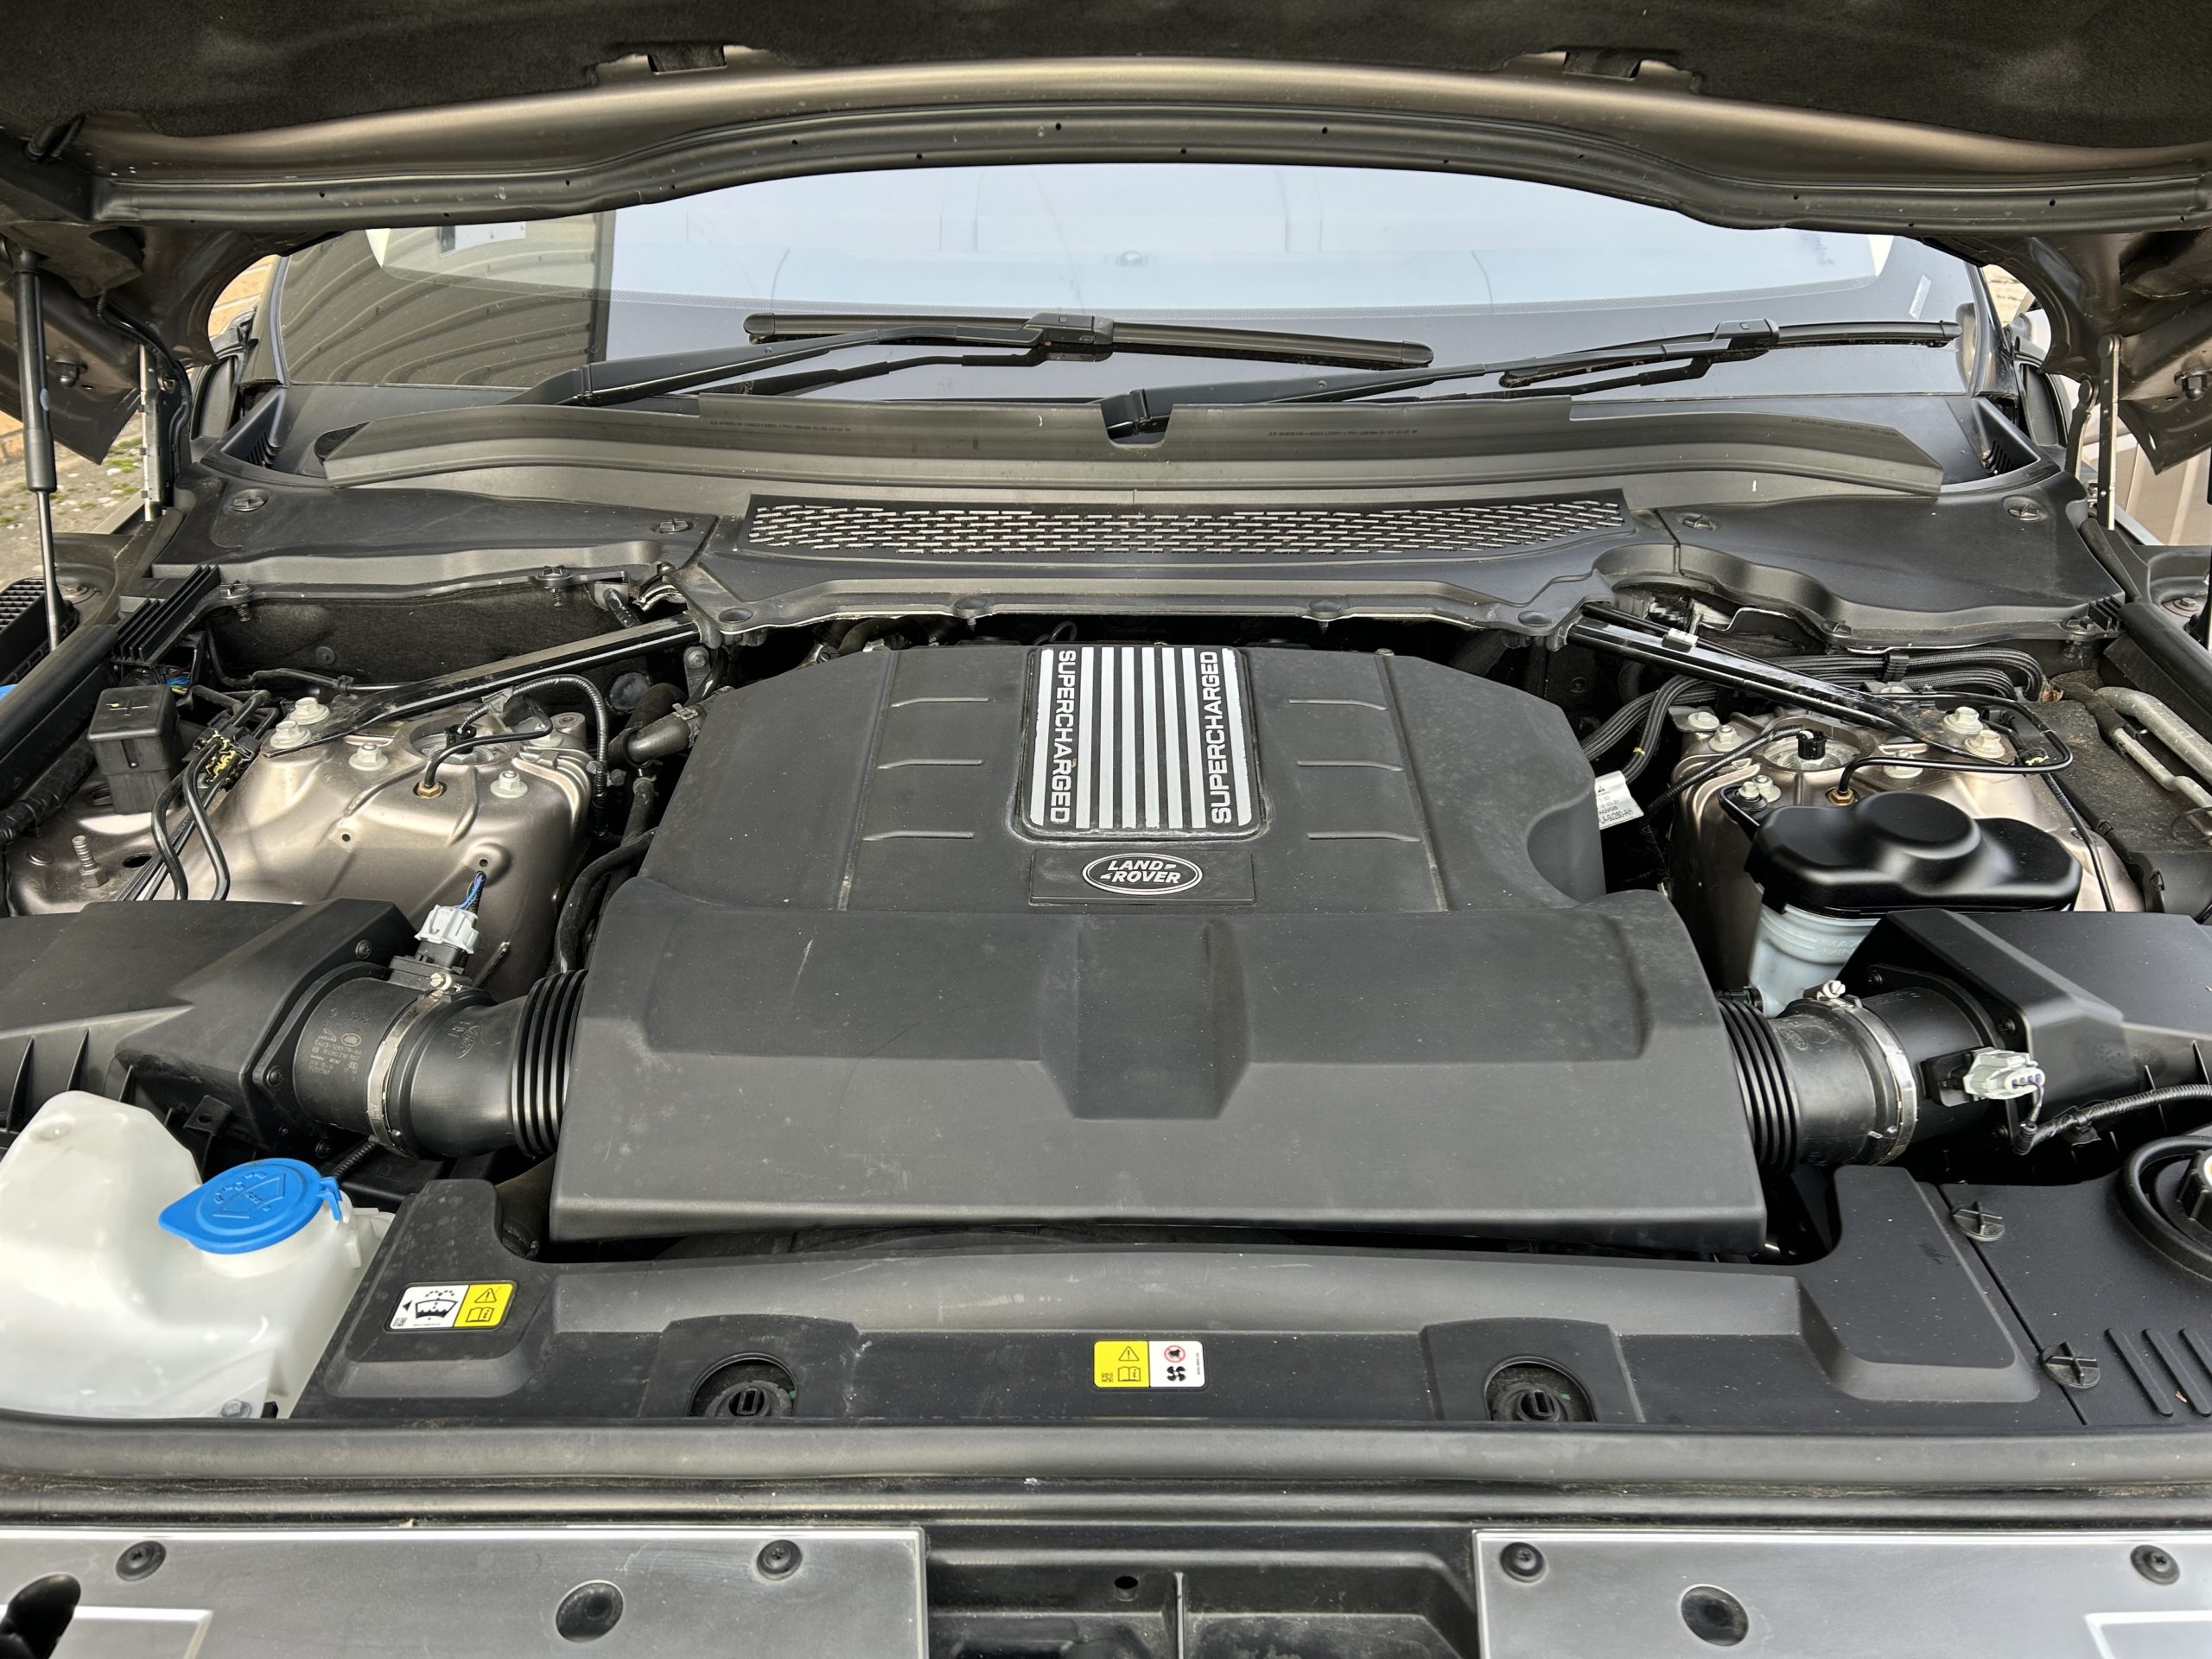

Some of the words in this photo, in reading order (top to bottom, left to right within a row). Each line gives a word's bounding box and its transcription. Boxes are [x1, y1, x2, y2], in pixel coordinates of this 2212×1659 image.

[1050, 649, 1077, 823] SUPERCHARGED
[1199, 651, 1232, 824] SUPERCHARGED
[1107, 859, 1165, 871] LAND
[1110, 871, 1182, 884] ROVER
